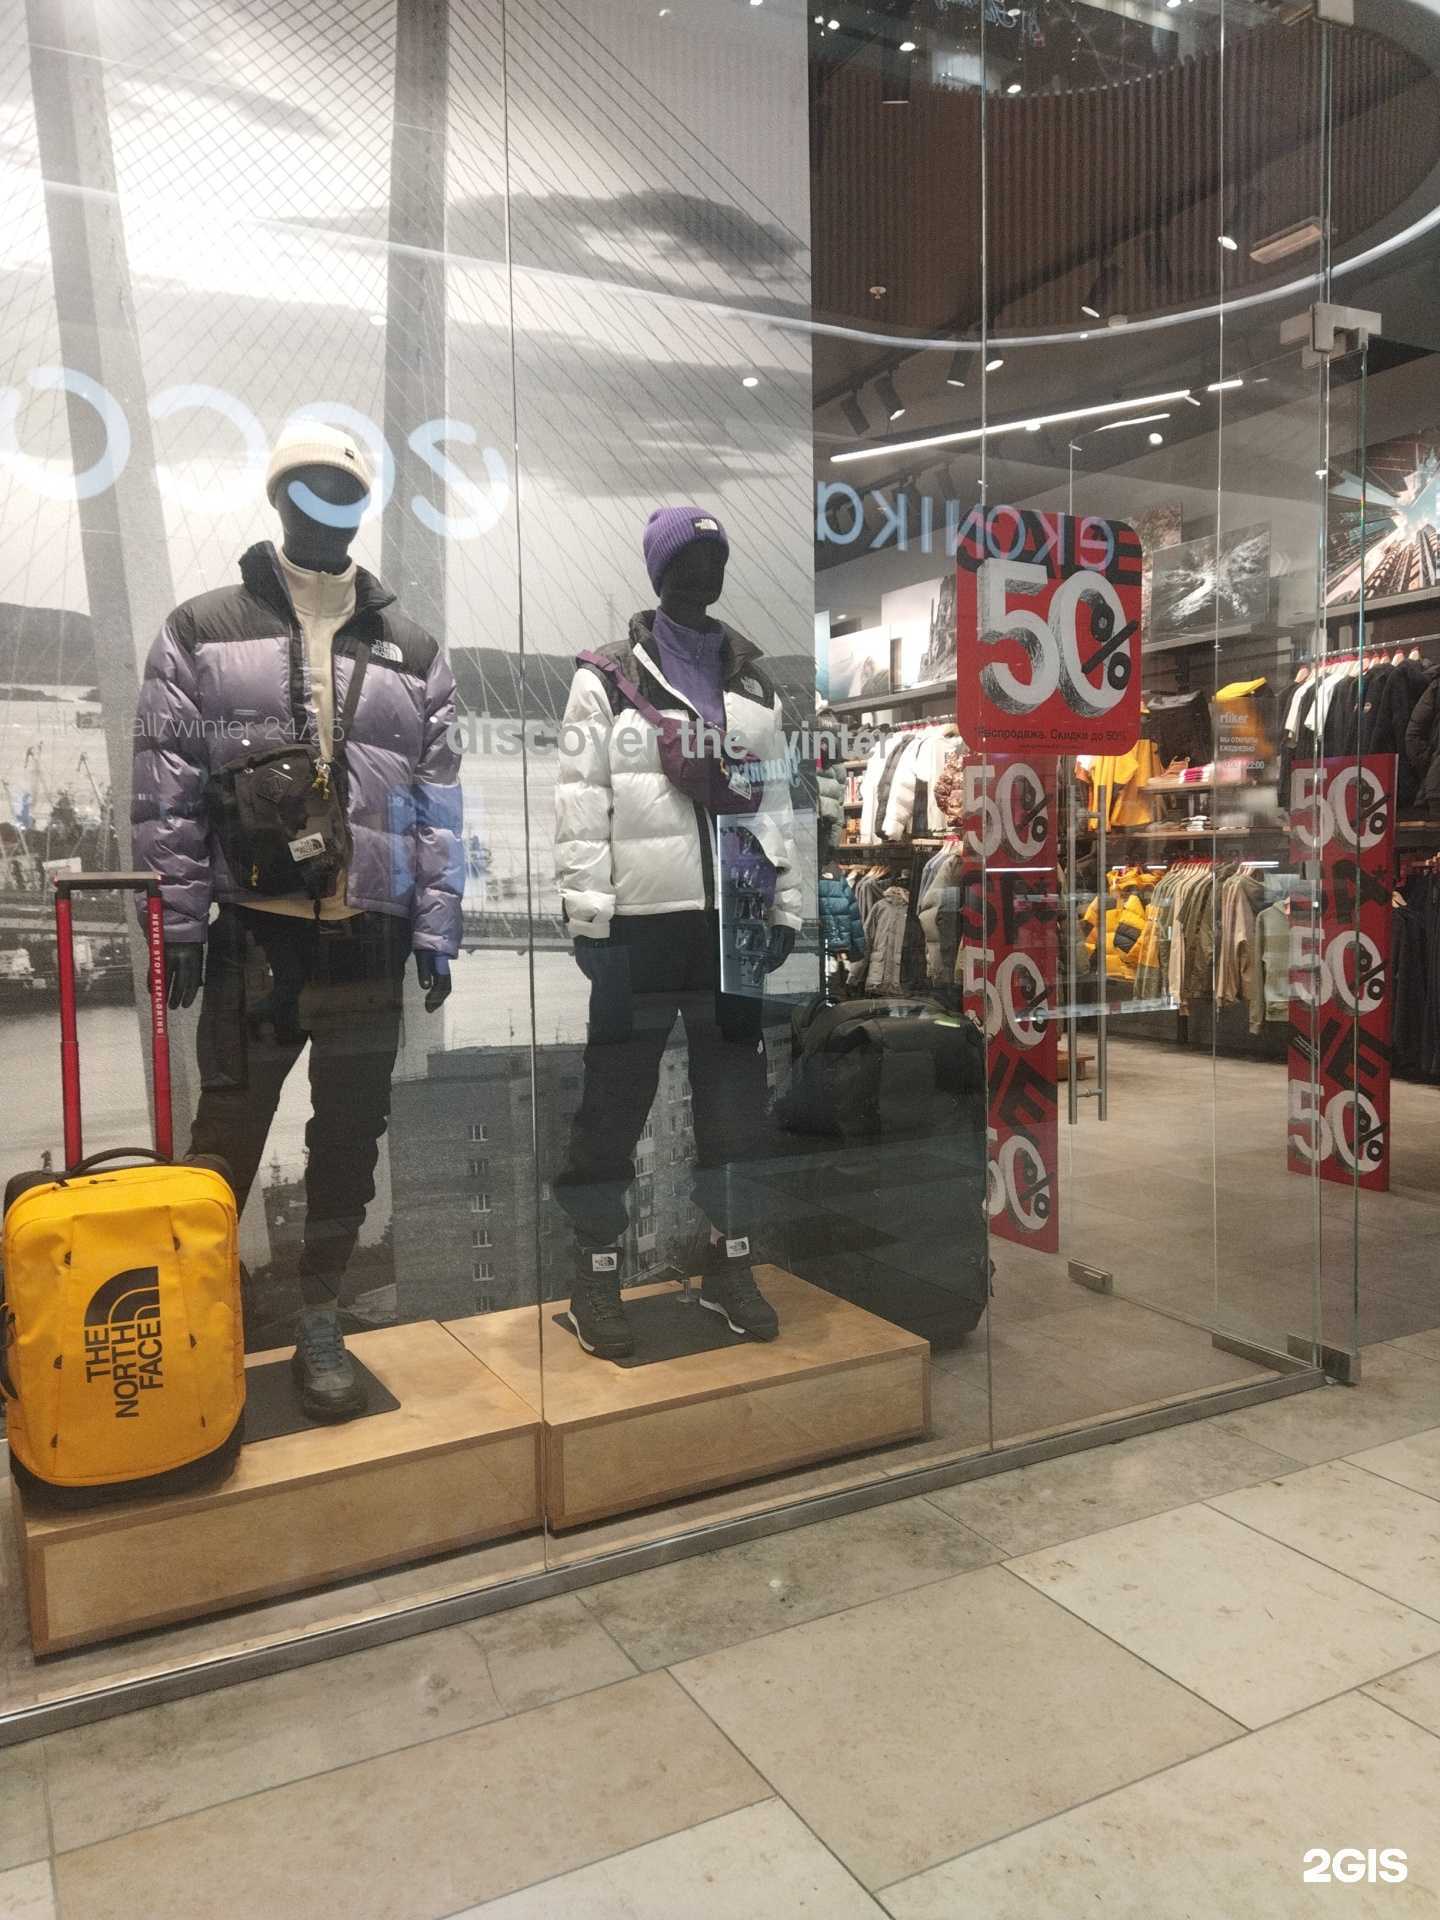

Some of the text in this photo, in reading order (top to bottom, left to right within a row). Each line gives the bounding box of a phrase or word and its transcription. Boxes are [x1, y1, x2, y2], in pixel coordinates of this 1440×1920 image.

[976, 558, 1139, 717] 50%
[446, 710, 897, 760] discover the winter
[963, 763, 1051, 862] 50%
[1290, 766, 1391, 852] 50%
[152, 913, 164, 1035] NEVER STOP EXPLORING
[962, 945, 1052, 1050] 50%
[1289, 926, 1388, 1016] 50%
[1289, 1078, 1388, 1174] 50%
[84, 1327, 112, 1384] THE
[111, 1324, 140, 1418] NORTH
[137, 1320, 164, 1390] FACE
